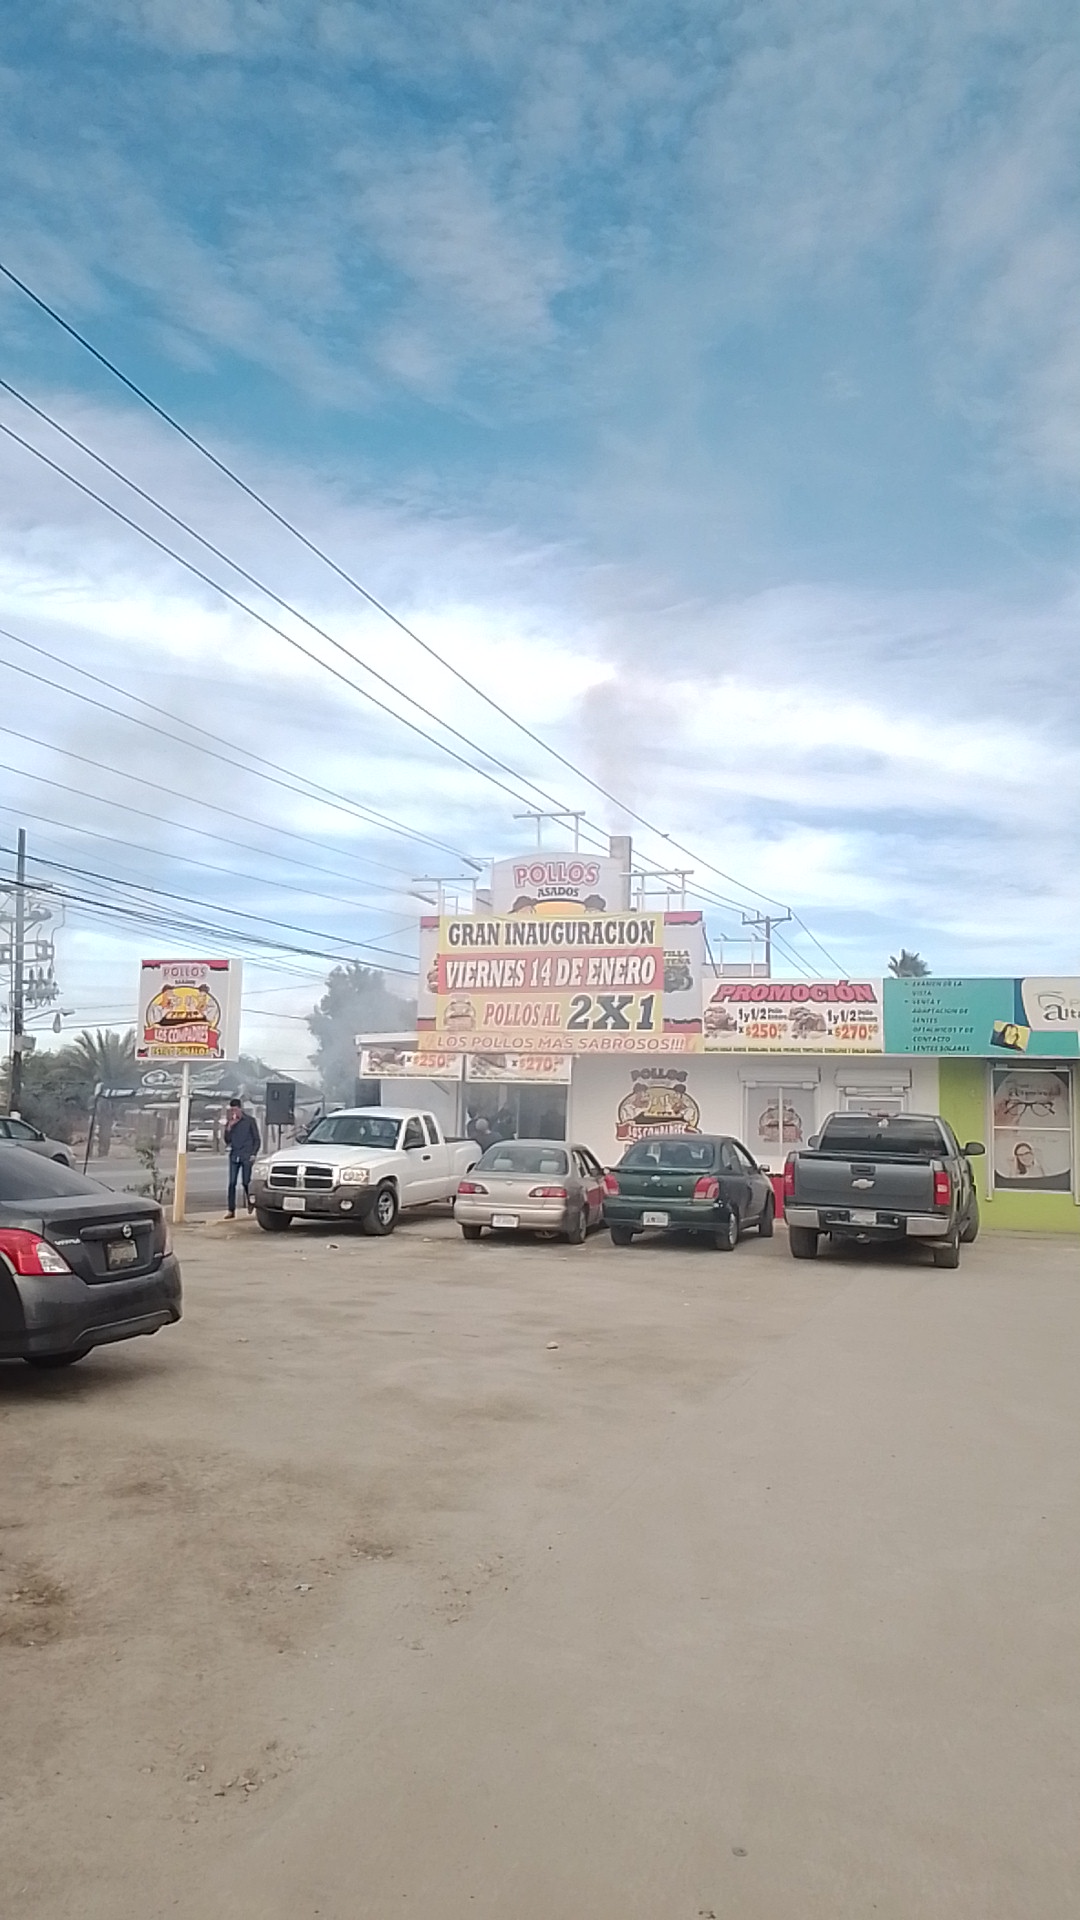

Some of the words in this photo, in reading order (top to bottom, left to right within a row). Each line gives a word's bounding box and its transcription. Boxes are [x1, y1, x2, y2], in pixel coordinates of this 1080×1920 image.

[514, 862, 600, 888] POLLOS
[538, 887, 580, 898] ASADOS
[449, 922, 501, 946] GRAN
[504, 919, 655, 945] INAUGURACION
[163, 966, 207, 977] POLLOS
[445, 959, 526, 989] VIERNES
[530, 959, 551, 987] 14
[554, 958, 583, 986] DE
[587, 955, 657, 986] ENERO
[710, 980, 878, 1003] PROMOCIÓN
[483, 1003, 539, 1026] POLLOS
[541, 1004, 561, 1026] AL
[567, 994, 655, 1031] 2X1
[155, 1028, 167, 1042] LOS
[437, 1036, 467, 1049] LOS
[471, 1036, 533, 1050] POLLOS
[578, 1036, 685, 1050] SABROSOS!!!
[631, 1067, 688, 1082] POLLOS
